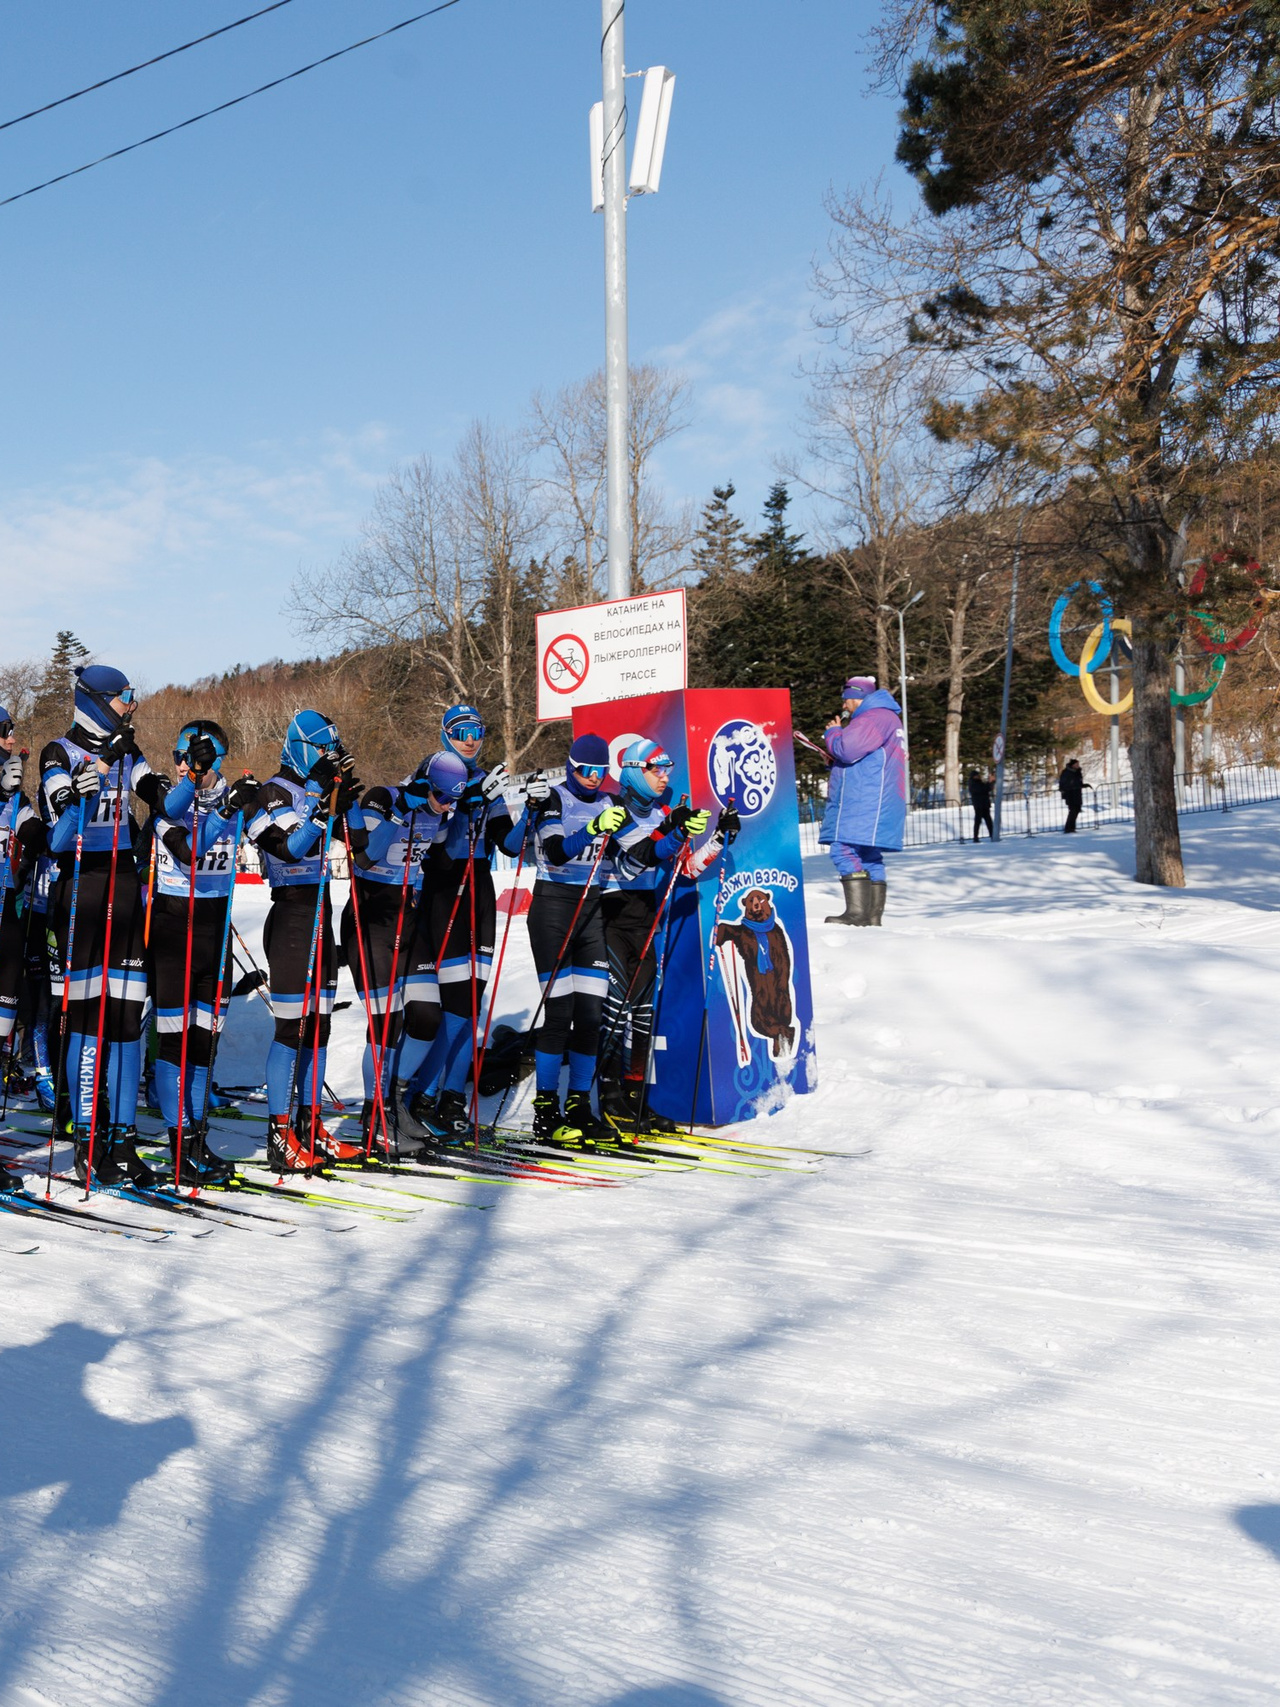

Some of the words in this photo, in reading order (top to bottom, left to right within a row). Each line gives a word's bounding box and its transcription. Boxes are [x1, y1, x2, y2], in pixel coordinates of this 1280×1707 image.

[607, 601, 649, 617] КАТАНИЕ
[651, 599, 666, 610] НА
[593, 623, 665, 641] ВЕЛОСИПЕДАХ
[666, 619, 681, 629] НА
[593, 641, 682, 663] ЛЫЖЕРОЛЛЕРНОЙ
[620, 668, 657, 682] ТРАССЕ
[755, 870, 798, 891] ВЗЯЛ?
[81, 1046, 97, 1117] SAKHALIN
